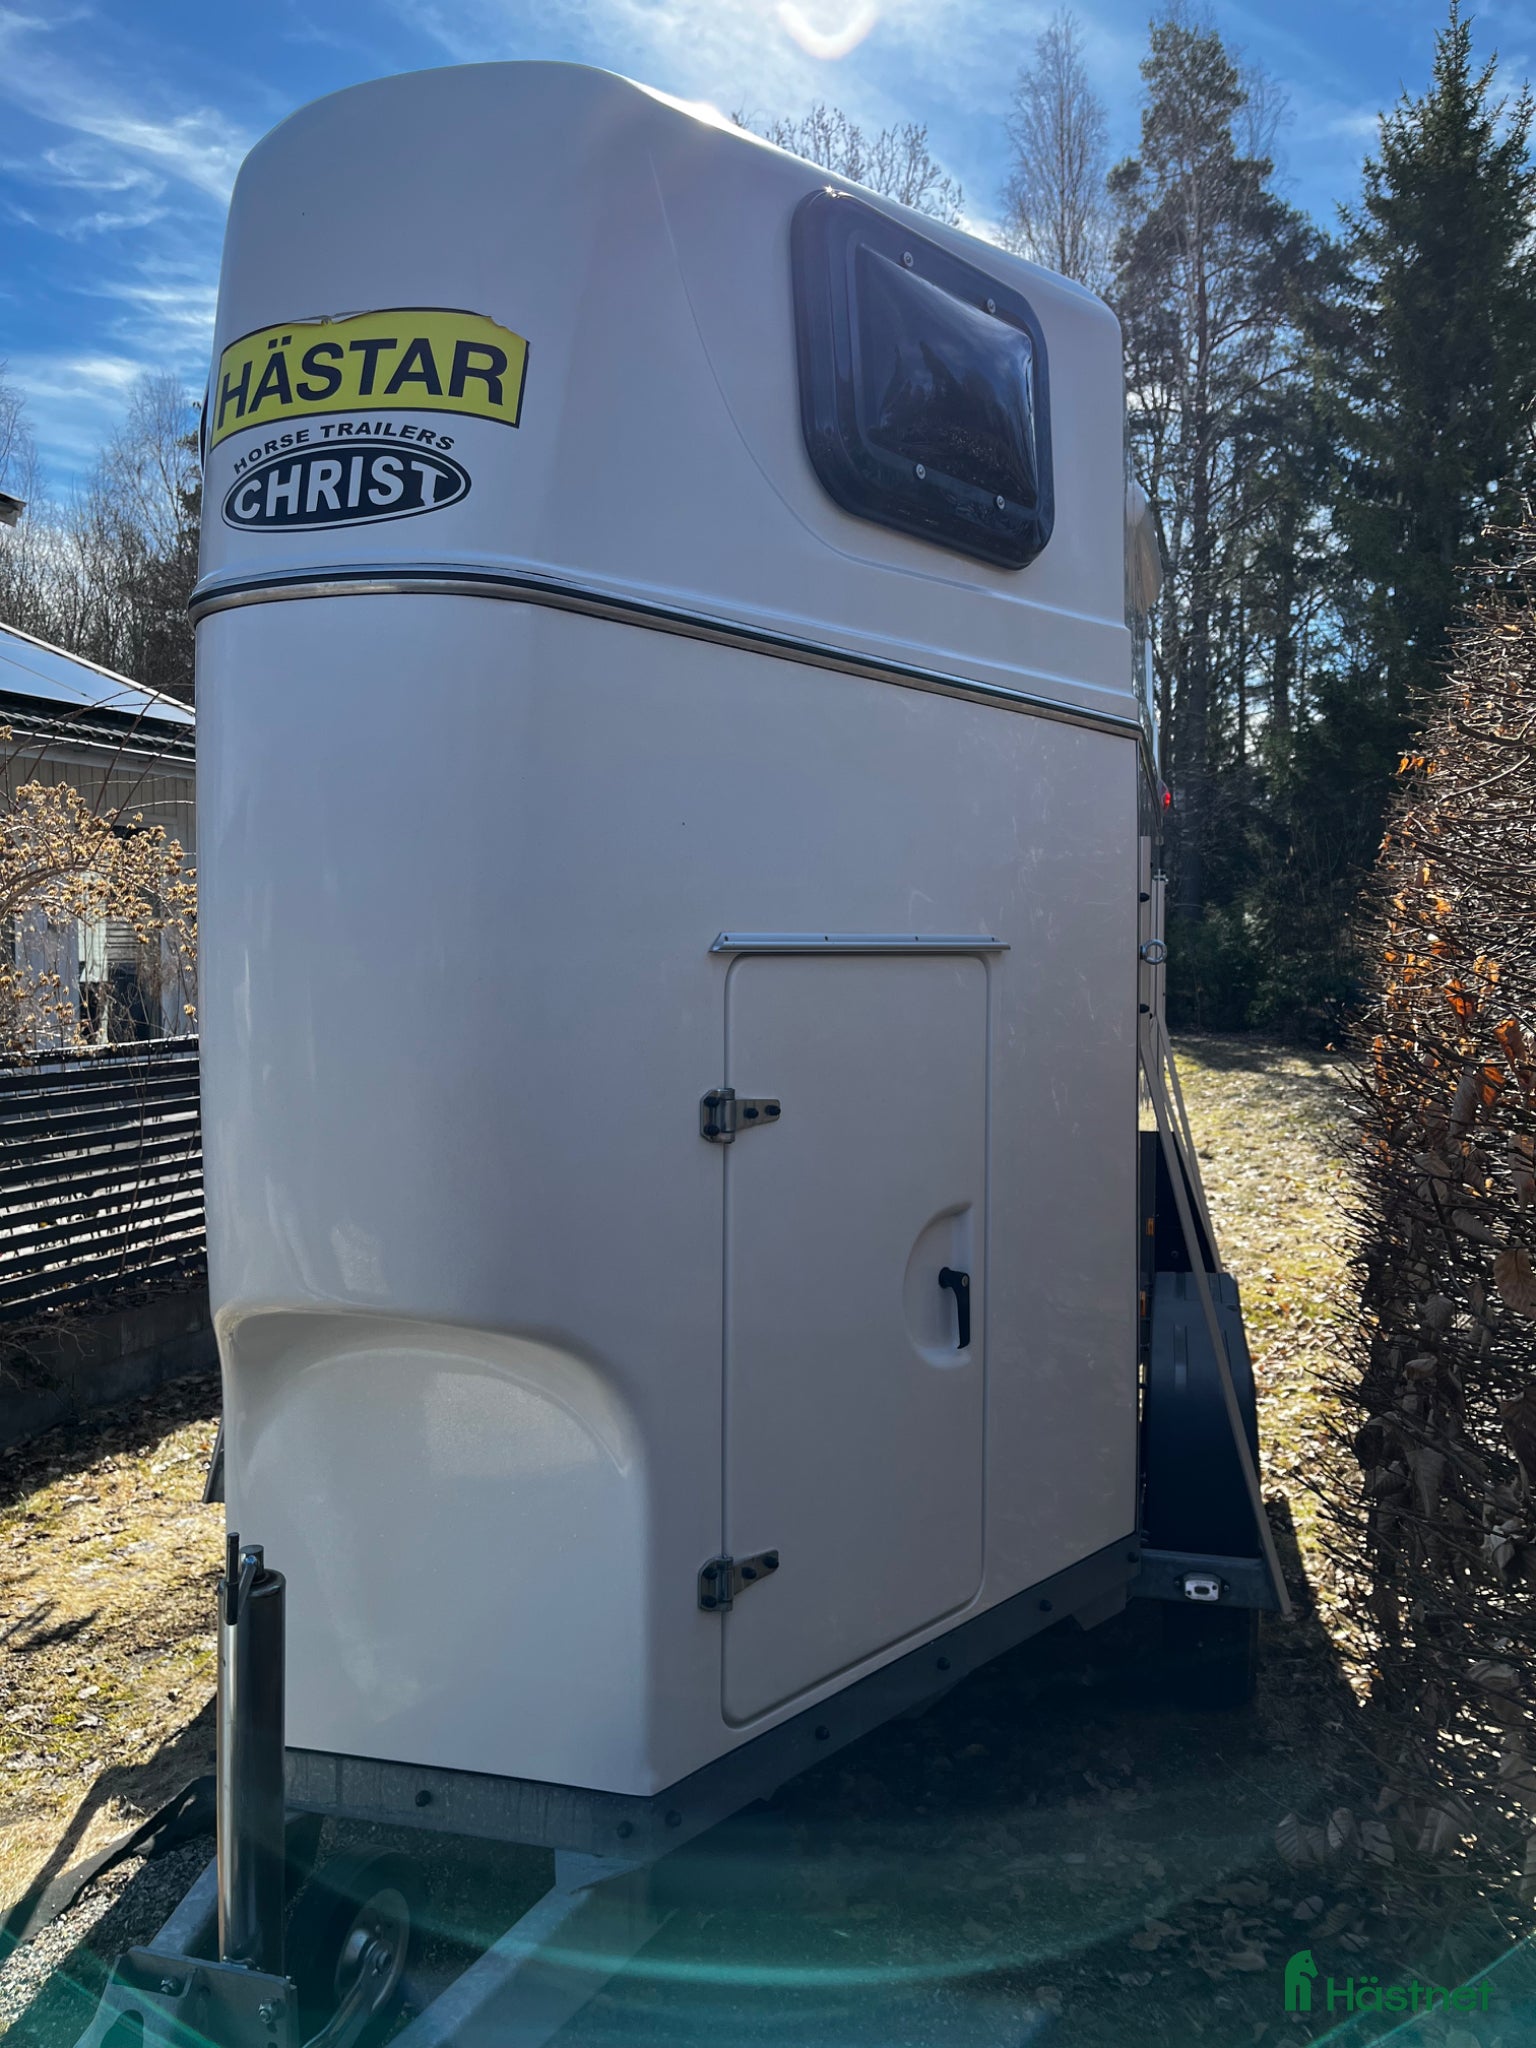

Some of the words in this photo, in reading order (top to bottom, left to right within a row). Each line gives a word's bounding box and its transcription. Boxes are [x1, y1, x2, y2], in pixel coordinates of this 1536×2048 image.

[217, 335, 508, 430] HÄSTAR
[233, 429, 310, 475] HORSE
[320, 422, 455, 451] TRAILERS
[234, 455, 449, 519] CHRIST
